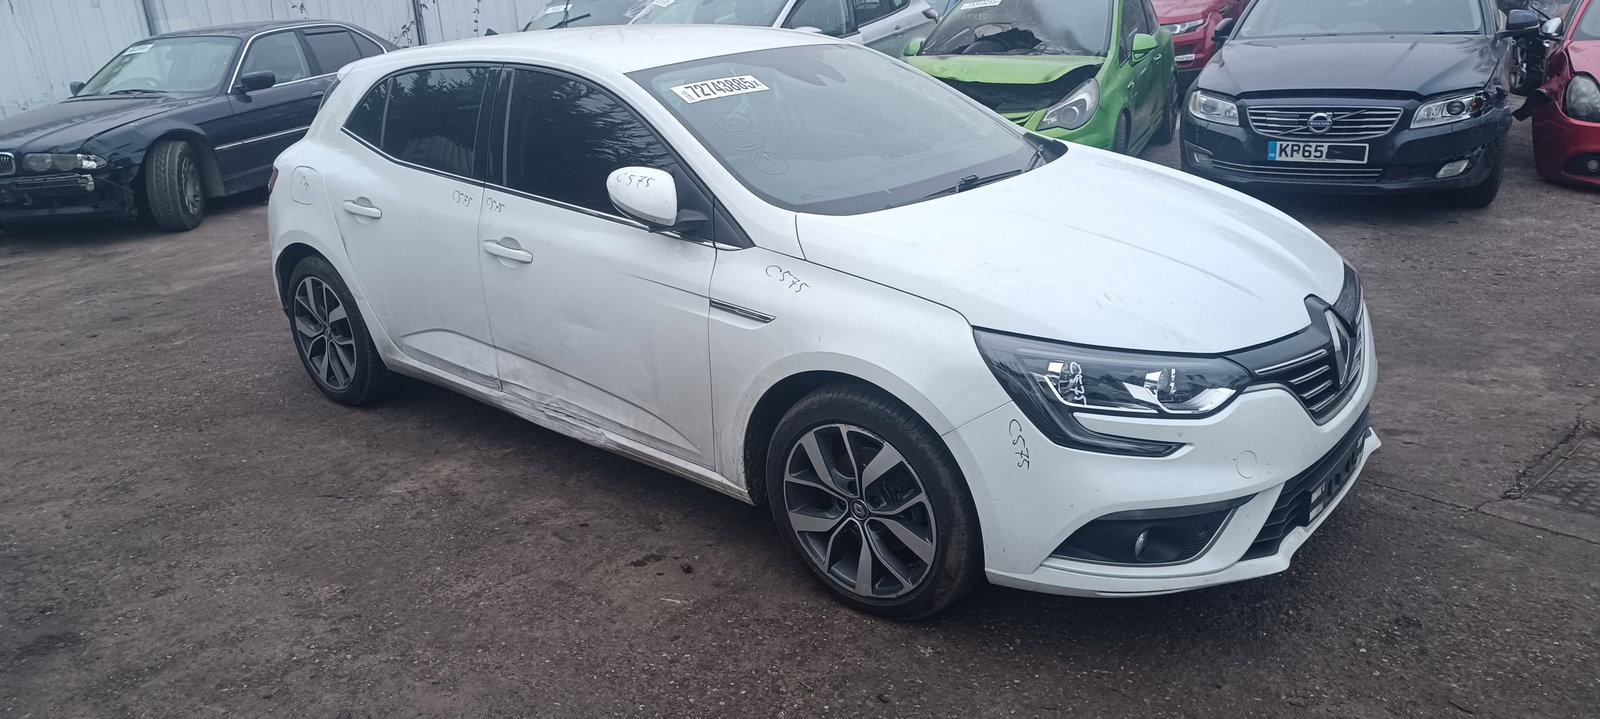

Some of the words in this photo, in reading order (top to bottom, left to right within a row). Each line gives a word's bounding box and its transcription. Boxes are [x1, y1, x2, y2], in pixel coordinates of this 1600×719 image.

[684, 77, 756, 98] 72743885
[1278, 143, 1325, 159] KP65
[616, 172, 656, 188] C575
[452, 190, 473, 207] C575
[486, 197, 506, 213] C575
[765, 265, 810, 293] C575
[1008, 418, 1030, 470] C575
